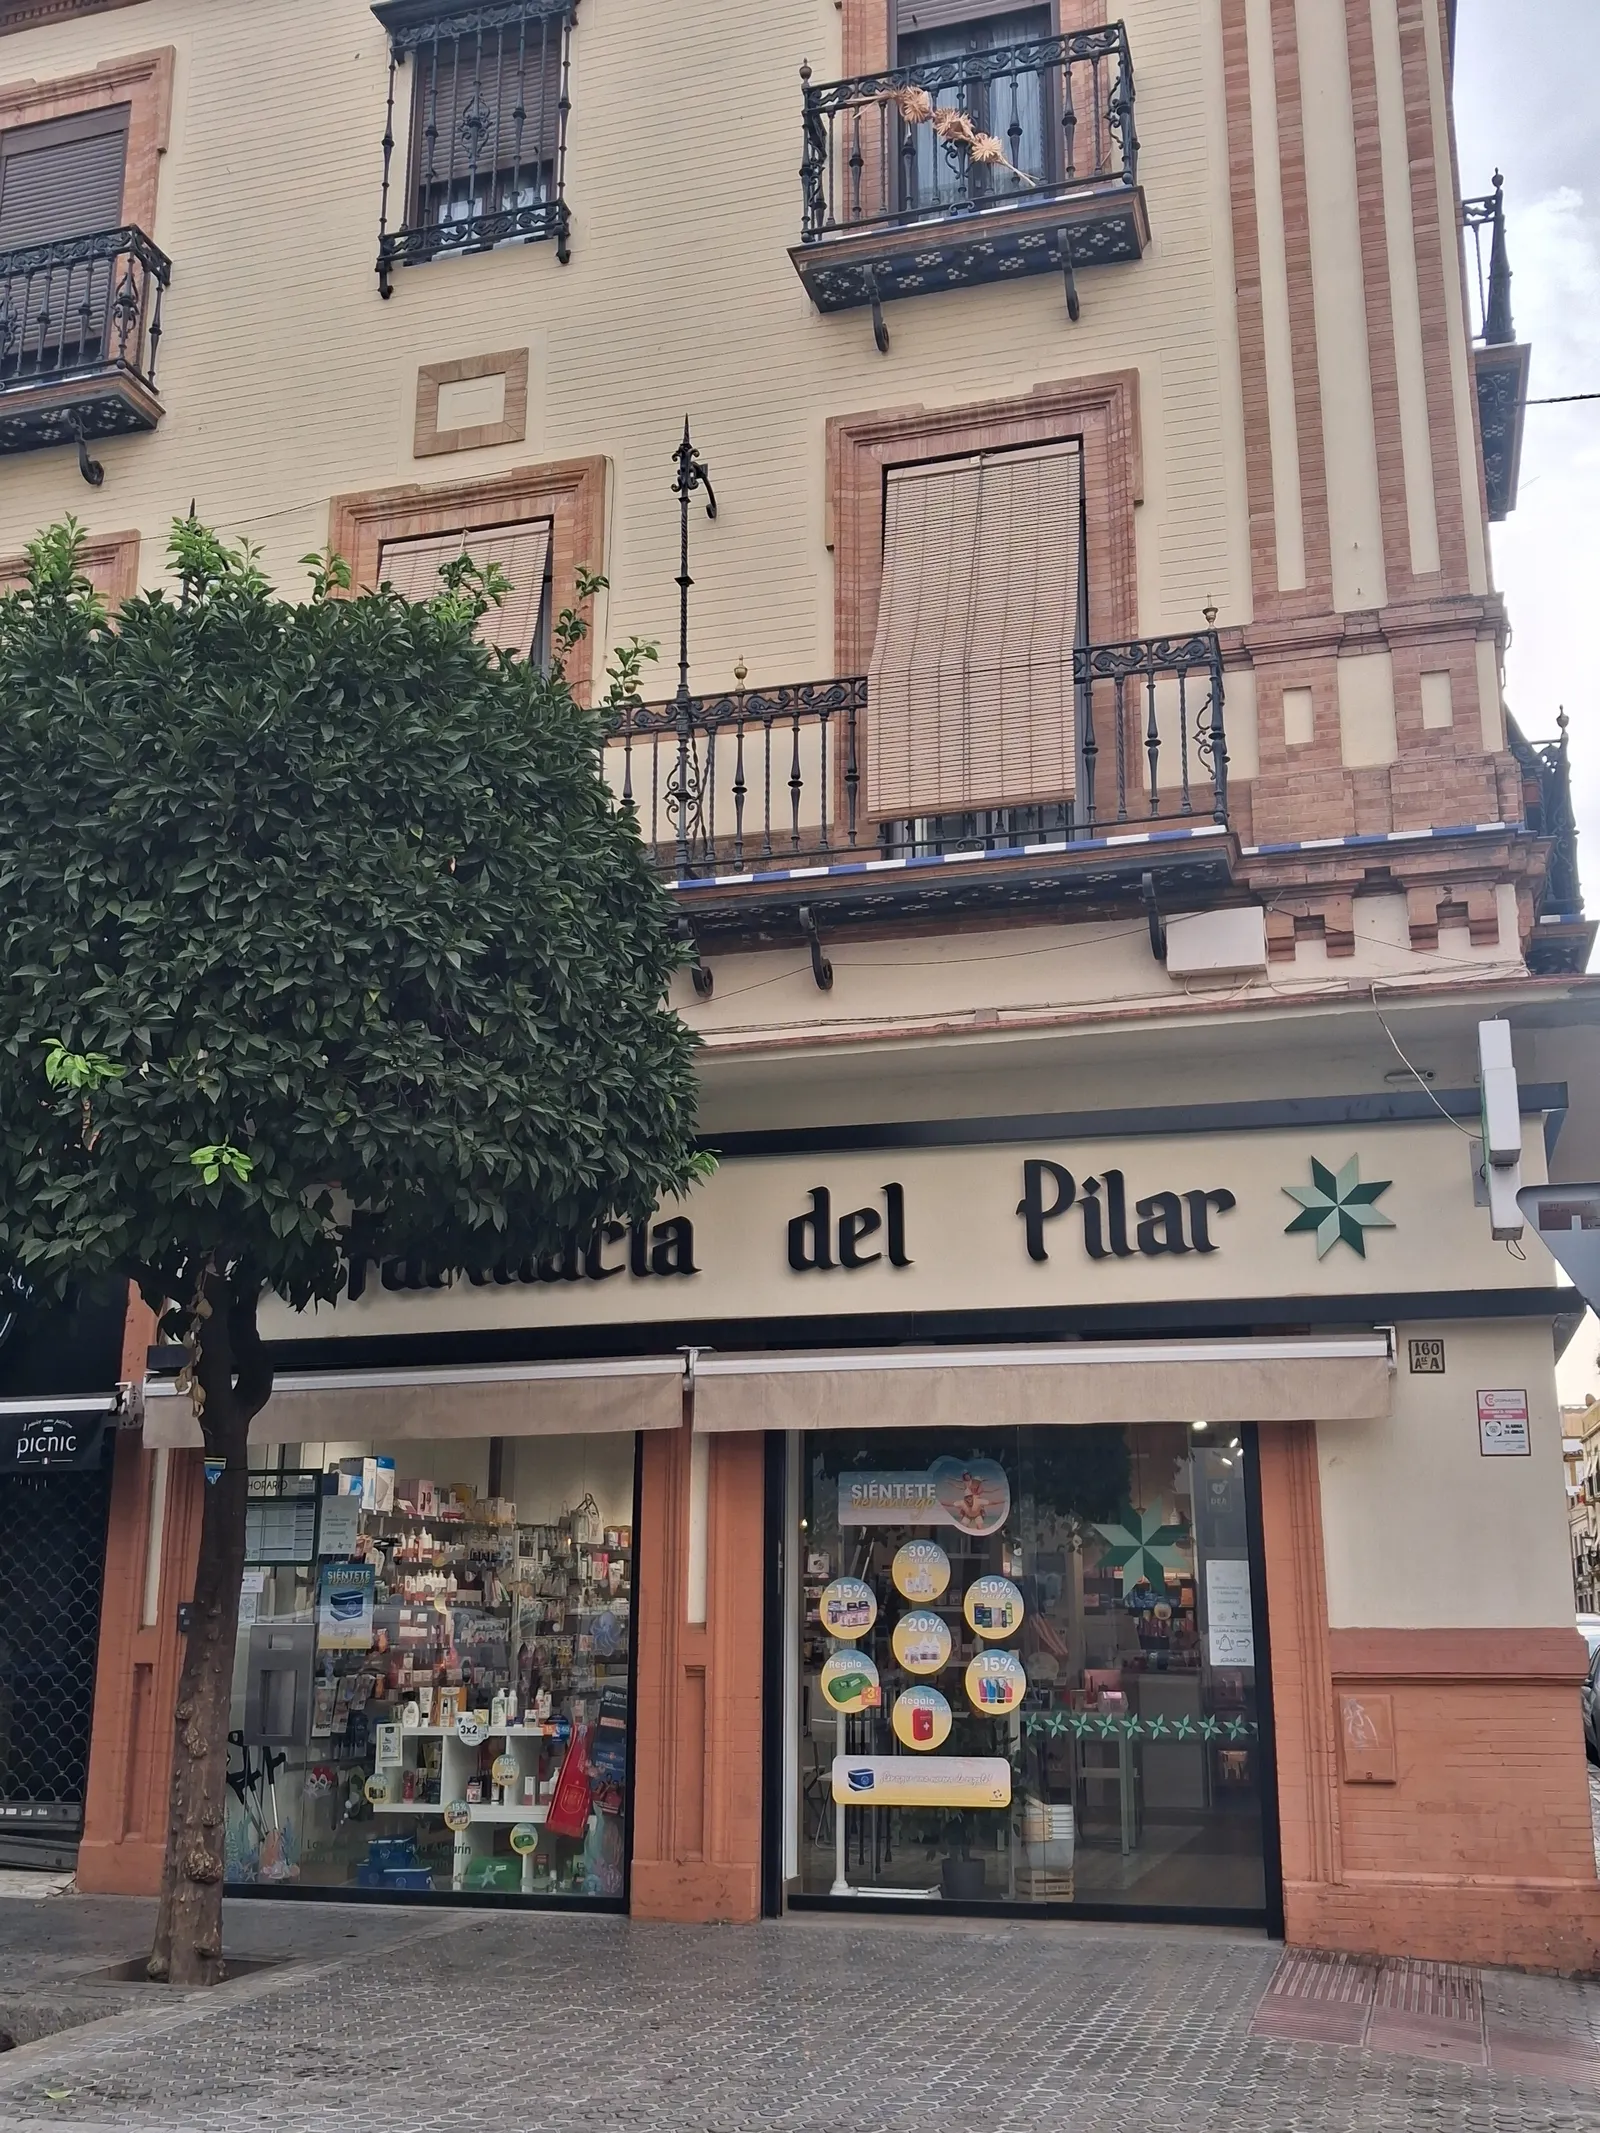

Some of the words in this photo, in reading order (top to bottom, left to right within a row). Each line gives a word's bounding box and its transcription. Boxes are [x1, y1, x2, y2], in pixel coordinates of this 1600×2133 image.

[787, 1181, 916, 1272] del
[1015, 1158, 1237, 1262] Pilar
[1414, 1342, 1440, 1356] 160
[851, 1480, 937, 1499] SIÉNTETE
[900, 1544, 938, 1558] -30%
[327, 1568, 371, 1580] SIÉNTETE
[827, 1583, 868, 1599] -15%
[971, 1581, 1011, 1595] -50%
[900, 1617, 944, 1634] -20%
[829, 1659, 863, 1671] Regalo
[973, 1656, 1016, 1672] -15%
[901, 1696, 936, 1707] Regalo
[460, 1724, 478, 1735] 3x2
